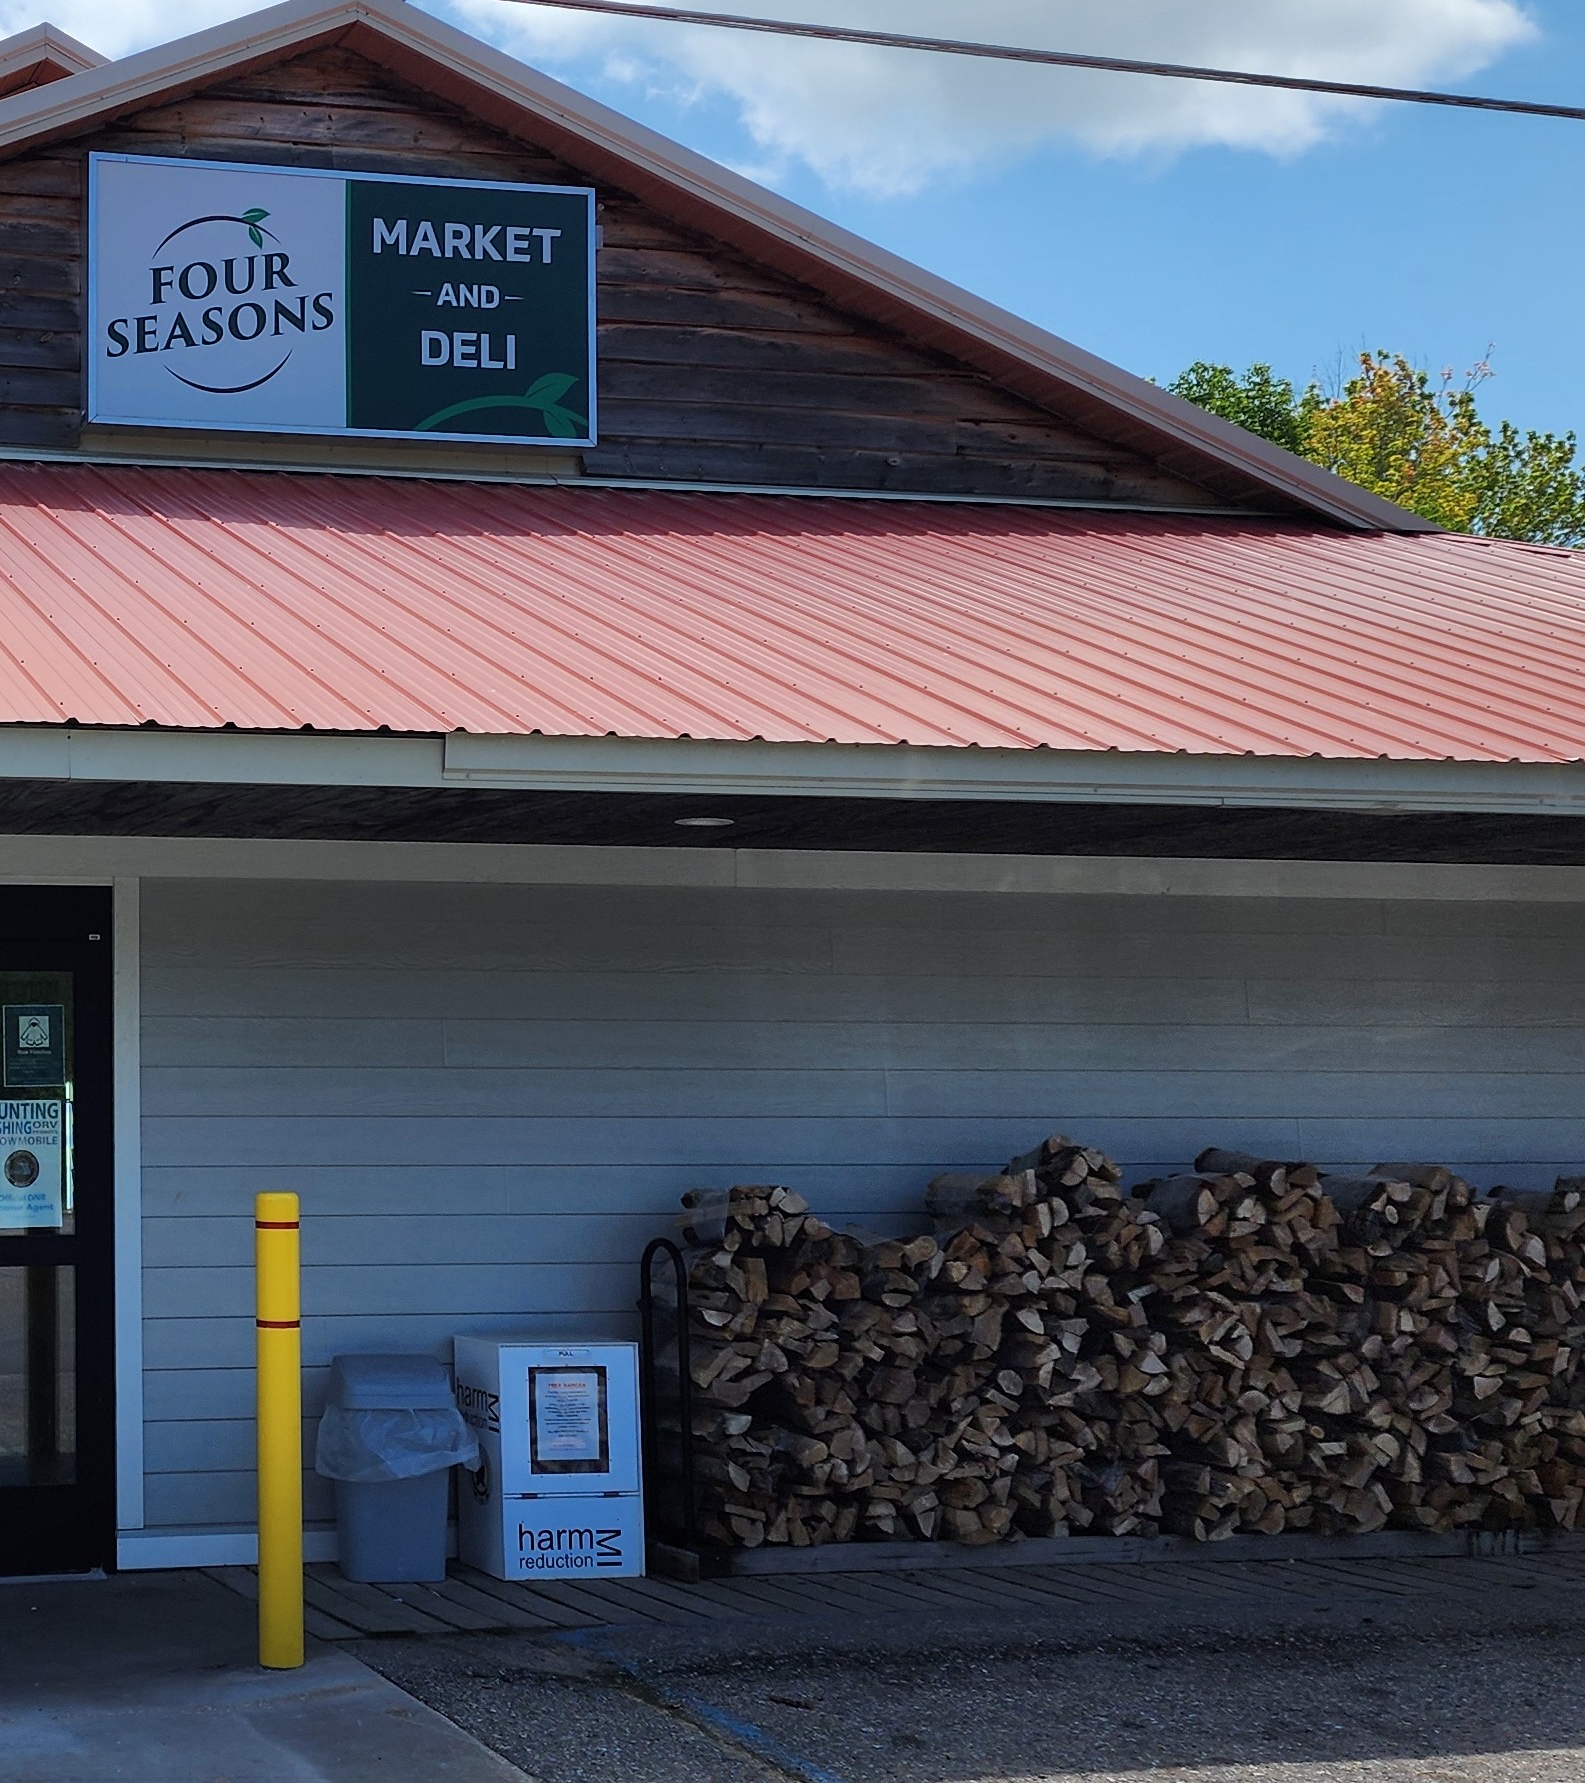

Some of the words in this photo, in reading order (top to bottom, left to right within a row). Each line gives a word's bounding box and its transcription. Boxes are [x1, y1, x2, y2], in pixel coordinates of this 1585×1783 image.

[372, 217, 562, 264] MARKET
[149, 252, 298, 305] FOUR
[436, 283, 500, 309] AND
[106, 292, 334, 358] SEASONS
[421, 330, 515, 370] DELI
[32, 1120, 58, 1129] ORV
[27, 1204, 54, 1212] Agent
[456, 1377, 488, 1412] harm
[518, 1523, 594, 1551] harm
[519, 1553, 594, 1570] reduction
